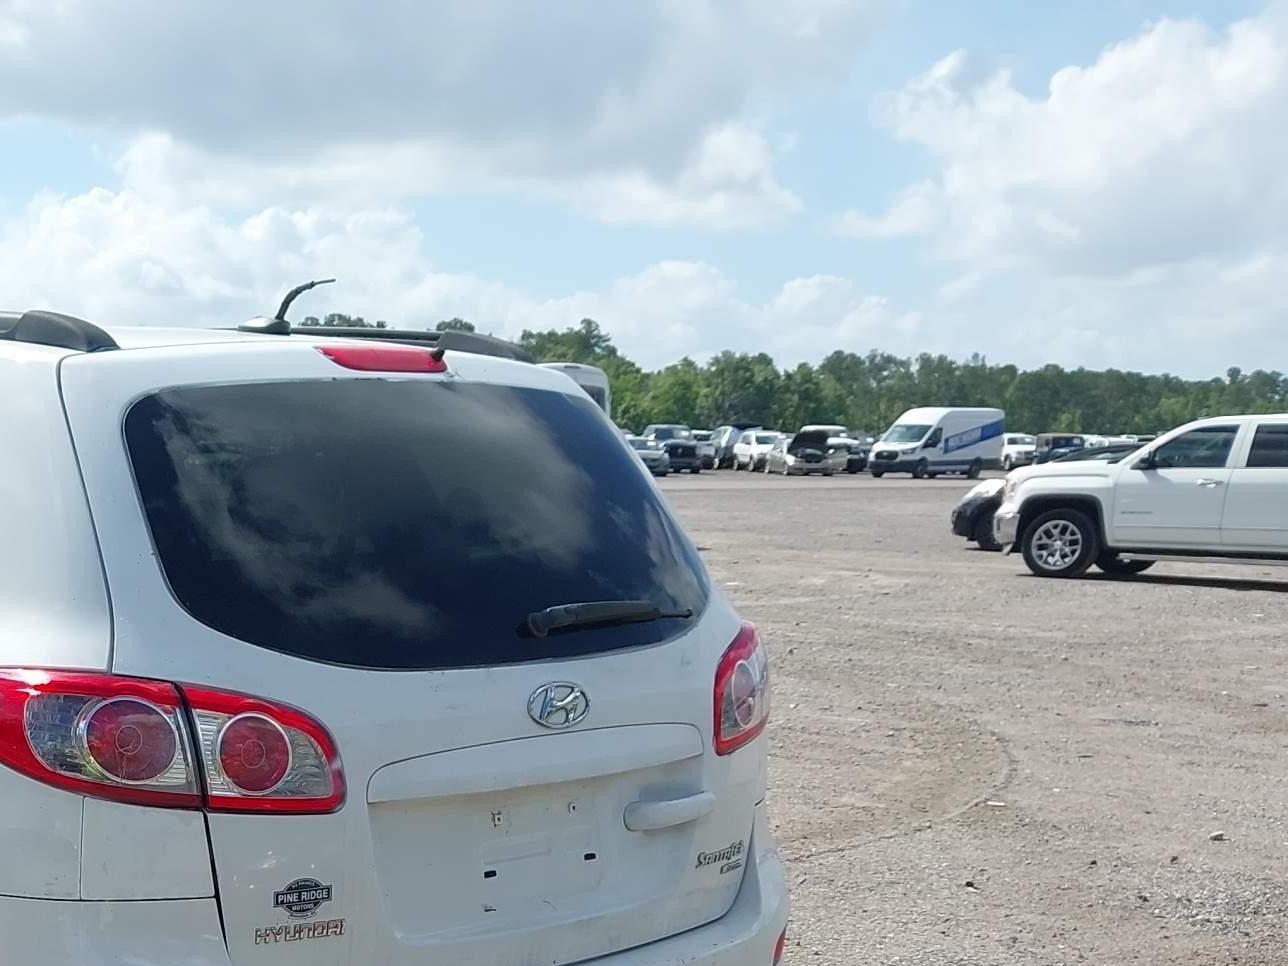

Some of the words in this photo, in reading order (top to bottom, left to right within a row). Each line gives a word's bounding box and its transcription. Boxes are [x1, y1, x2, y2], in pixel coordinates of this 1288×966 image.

[278, 892, 300, 904] PINE
[301, 888, 329, 901] RIDGE
[255, 918, 346, 945] HYUNDAI
